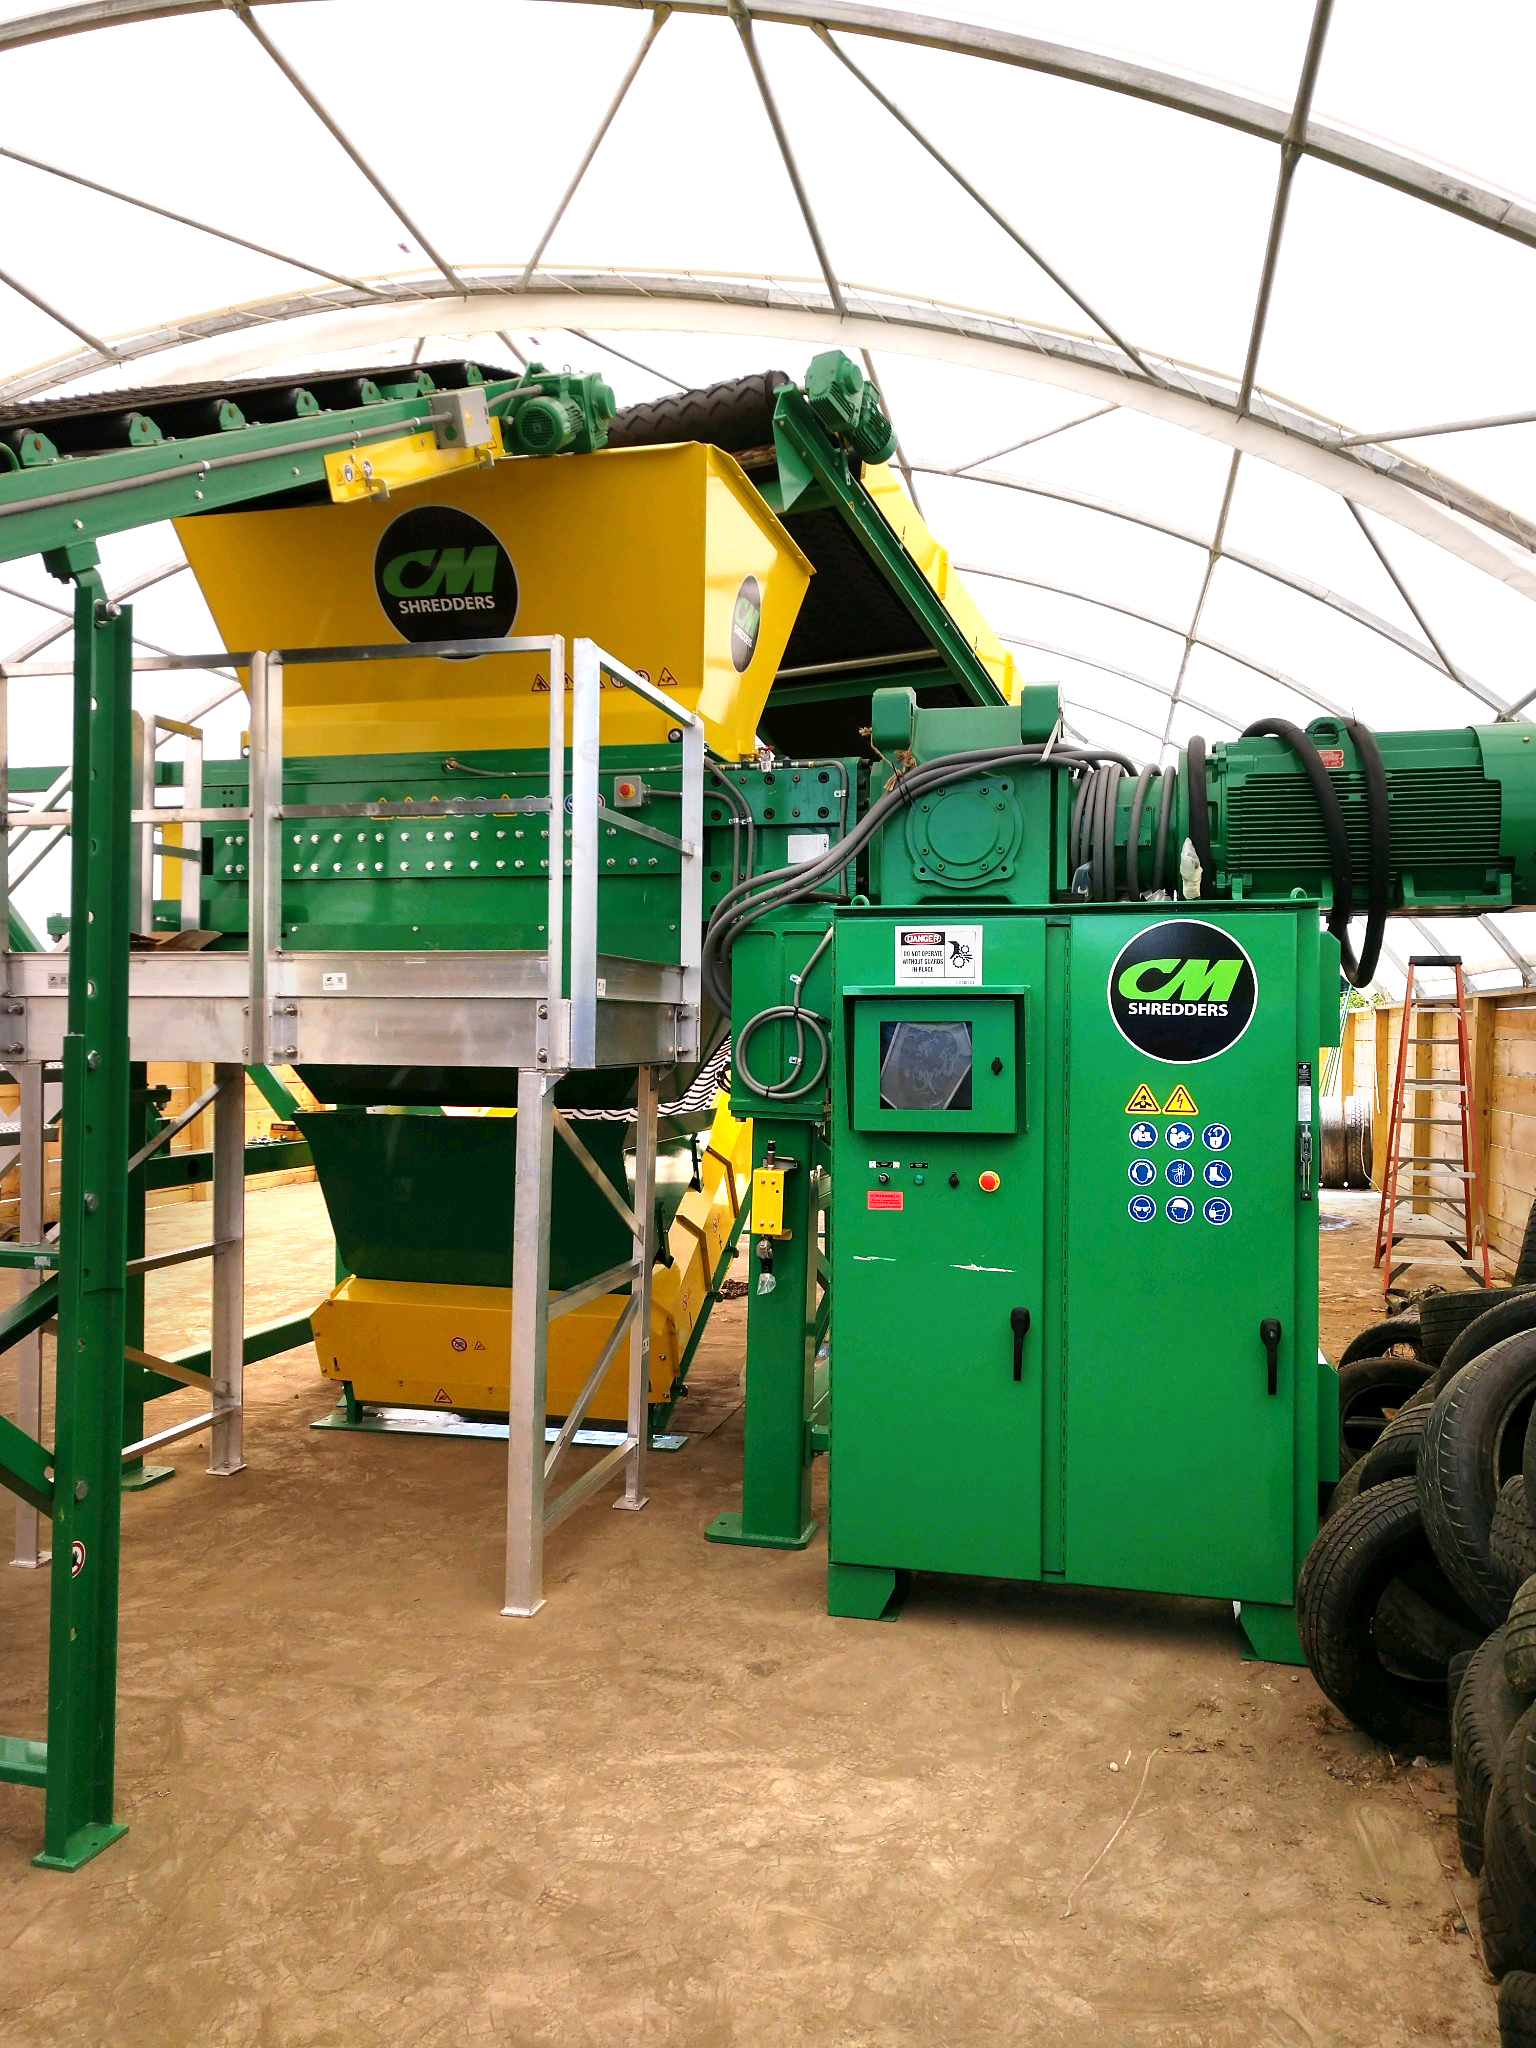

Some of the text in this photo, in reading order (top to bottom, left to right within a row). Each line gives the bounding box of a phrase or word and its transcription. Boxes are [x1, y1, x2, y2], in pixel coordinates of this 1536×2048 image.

[383, 545, 497, 597] CM
[399, 596, 495, 614] SHREDDERS
[735, 597, 760, 638] CM
[907, 934, 939, 942] DANGER
[1118, 959, 1244, 1001] CM
[1127, 1002, 1229, 1017] SHREDDERS
